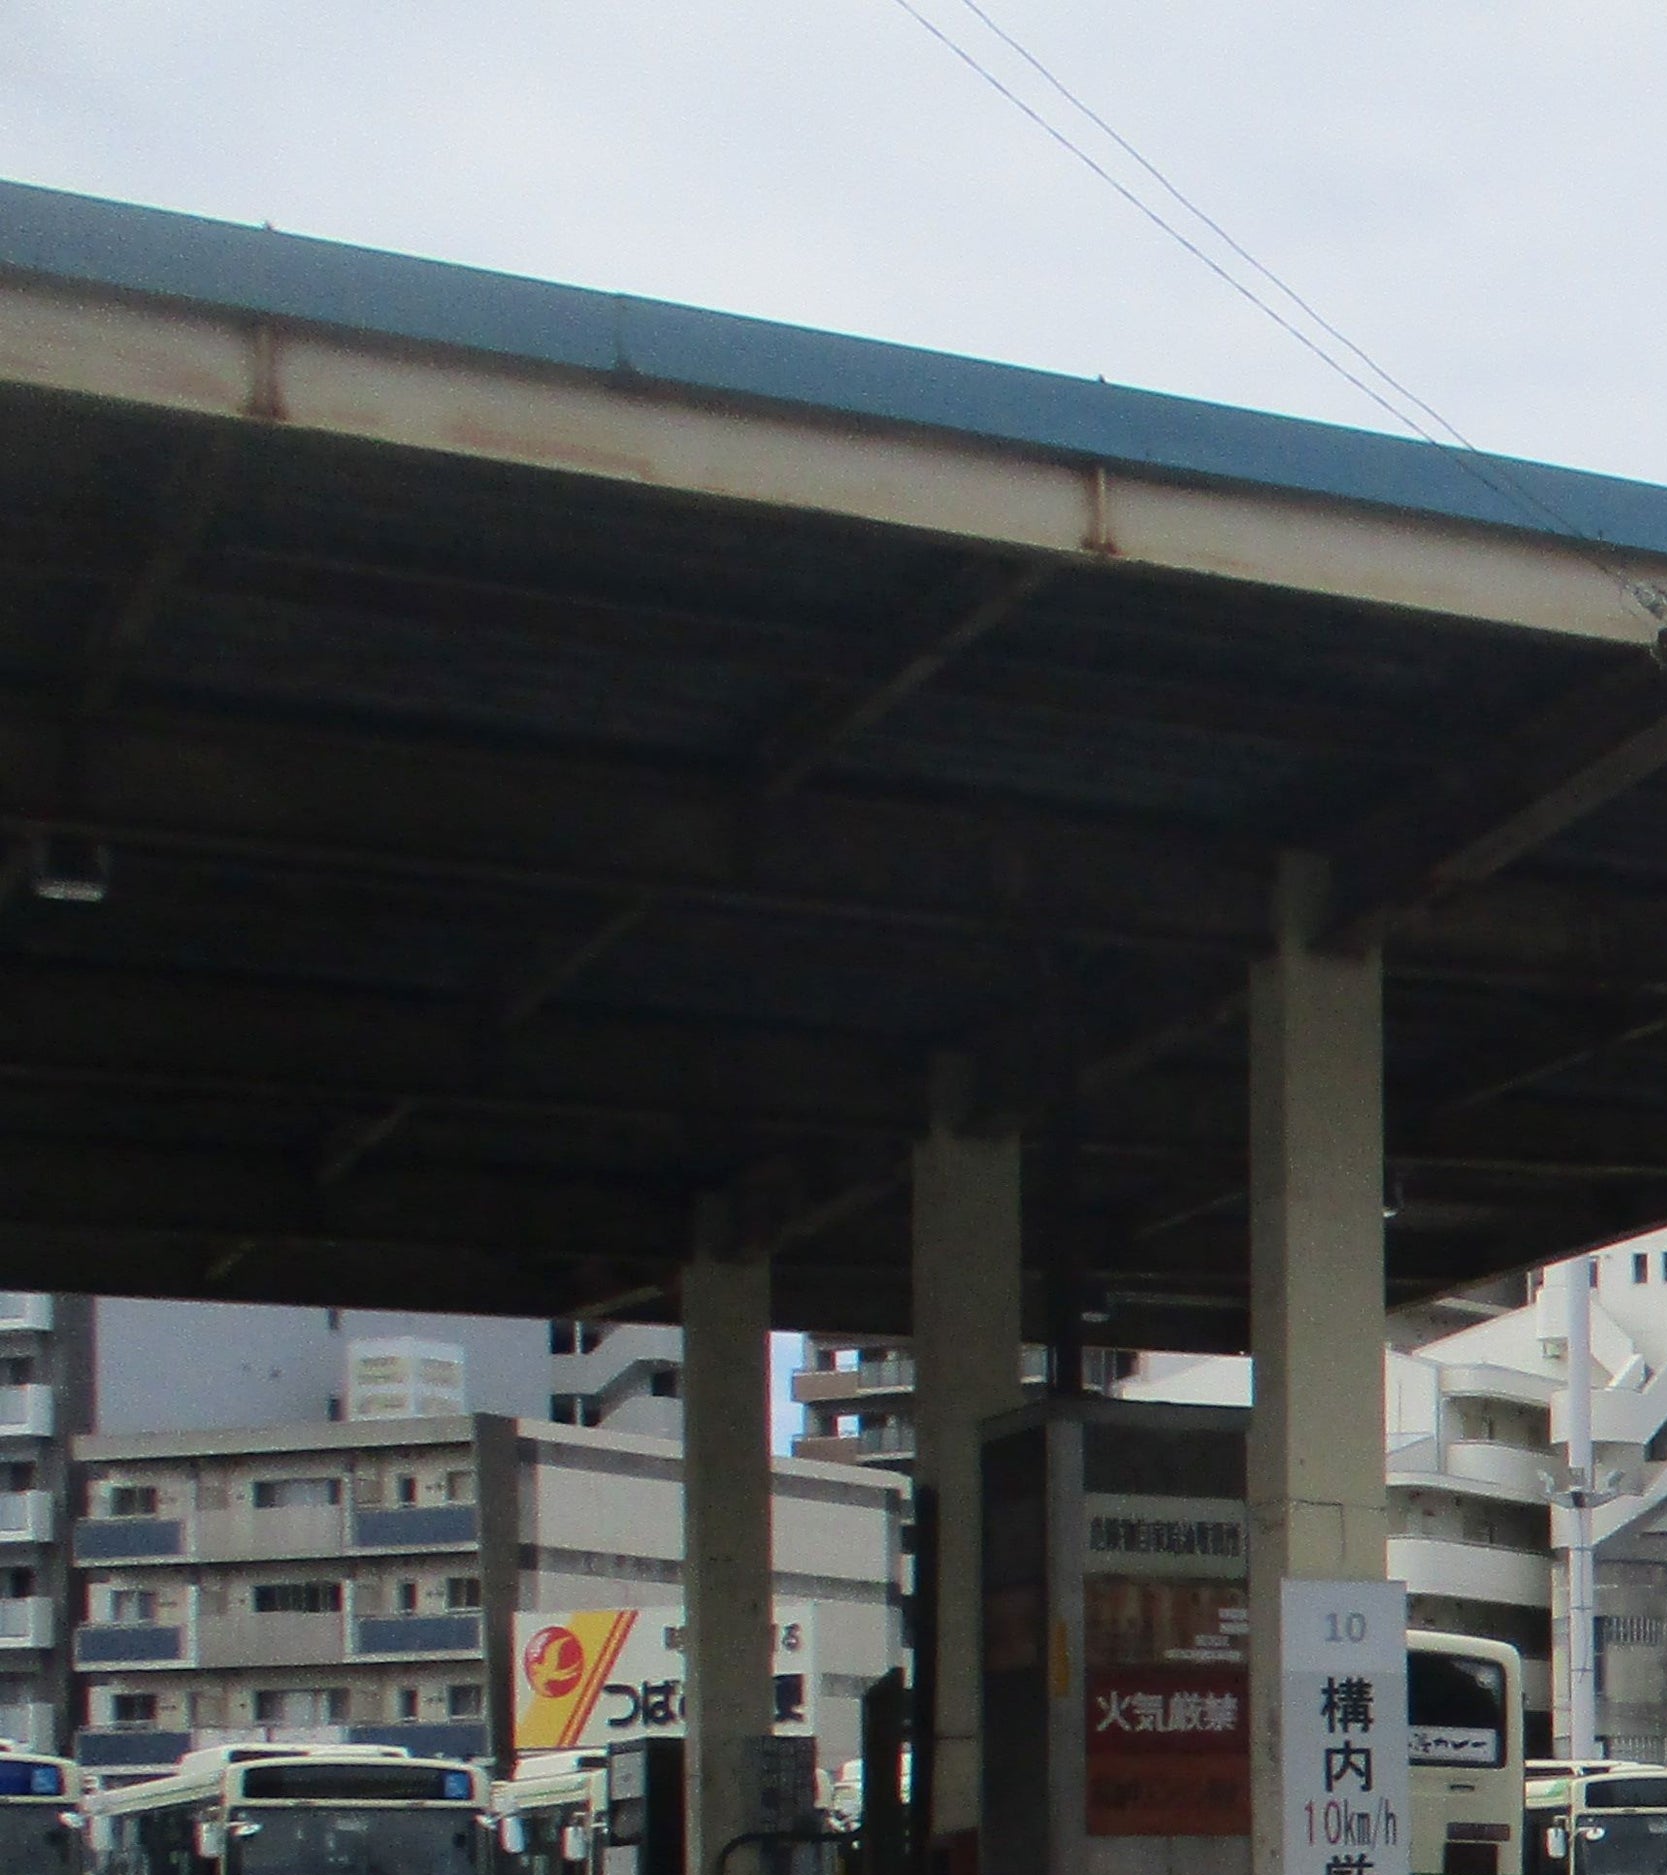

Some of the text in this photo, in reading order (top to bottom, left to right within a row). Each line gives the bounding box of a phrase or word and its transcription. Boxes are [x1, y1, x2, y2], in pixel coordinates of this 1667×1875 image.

[1325, 1612, 1367, 1643] 10
[602, 1678, 686, 1727] つば
[1096, 1690, 1239, 1733] 火気厳禁
[1320, 1676, 1375, 1793] 構内
[1304, 1799, 1398, 1850] 10km/h
